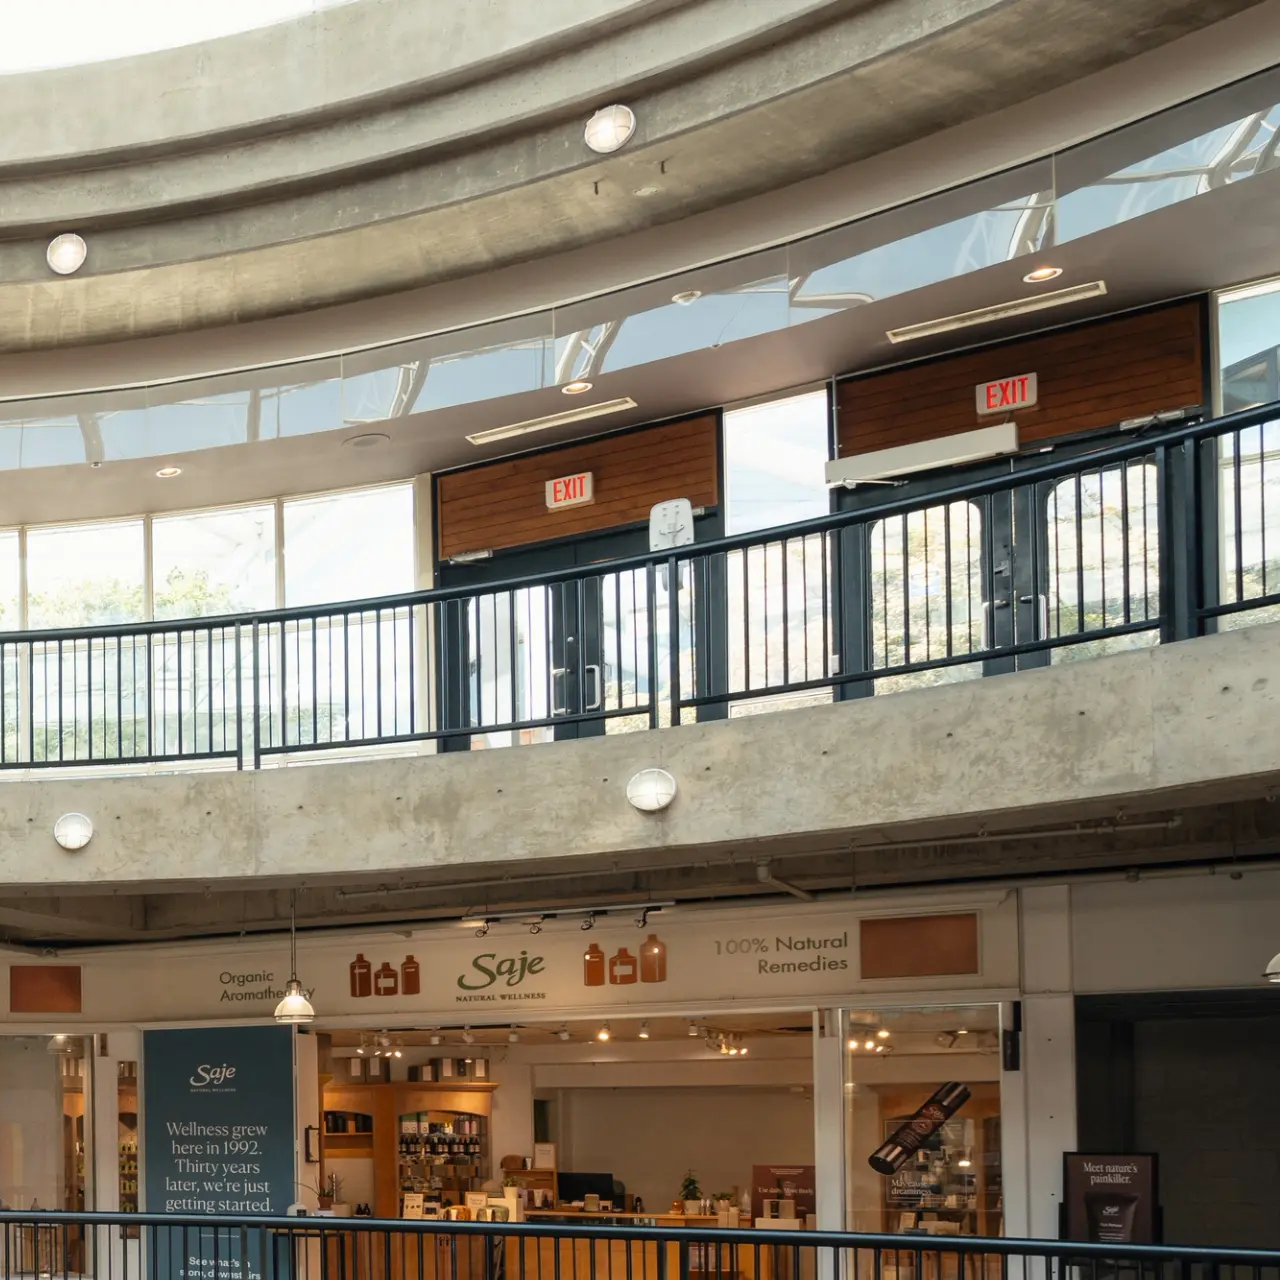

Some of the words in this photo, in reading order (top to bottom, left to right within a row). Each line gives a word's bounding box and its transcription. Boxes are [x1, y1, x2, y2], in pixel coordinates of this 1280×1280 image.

[986, 376, 1028, 409] EXIT
[553, 475, 585, 503] EXIT
[714, 937, 769, 955] 100%
[776, 932, 848, 952] Natural
[457, 951, 546, 991] Saje
[758, 955, 848, 974] Remedies
[220, 970, 274, 987] Organic
[456, 994, 496, 1002] NATURAL
[499, 992, 547, 1001] WELLNESS
[190, 1064, 236, 1086] Saje
[166, 1122, 229, 1137] Wellness
[232, 1124, 268, 1140] grew
[172, 1140, 204, 1155] here
[206, 1141, 220, 1155] in
[224, 1140, 263, 1155] 1992.
[175, 1159, 219, 1177] Thirty
[222, 1161, 260, 1177] years
[1083, 1163, 1103, 1173] Meet
[1105, 1163, 1138, 1173] nature's
[166, 1177, 200, 1193] later,
[203, 1178, 241, 1193] we're
[243, 1179, 270, 1196] just
[1090, 1174, 1132, 1186] painkiller.
[165, 1196, 216, 1213] getting
[218, 1197, 274, 1213] started.
